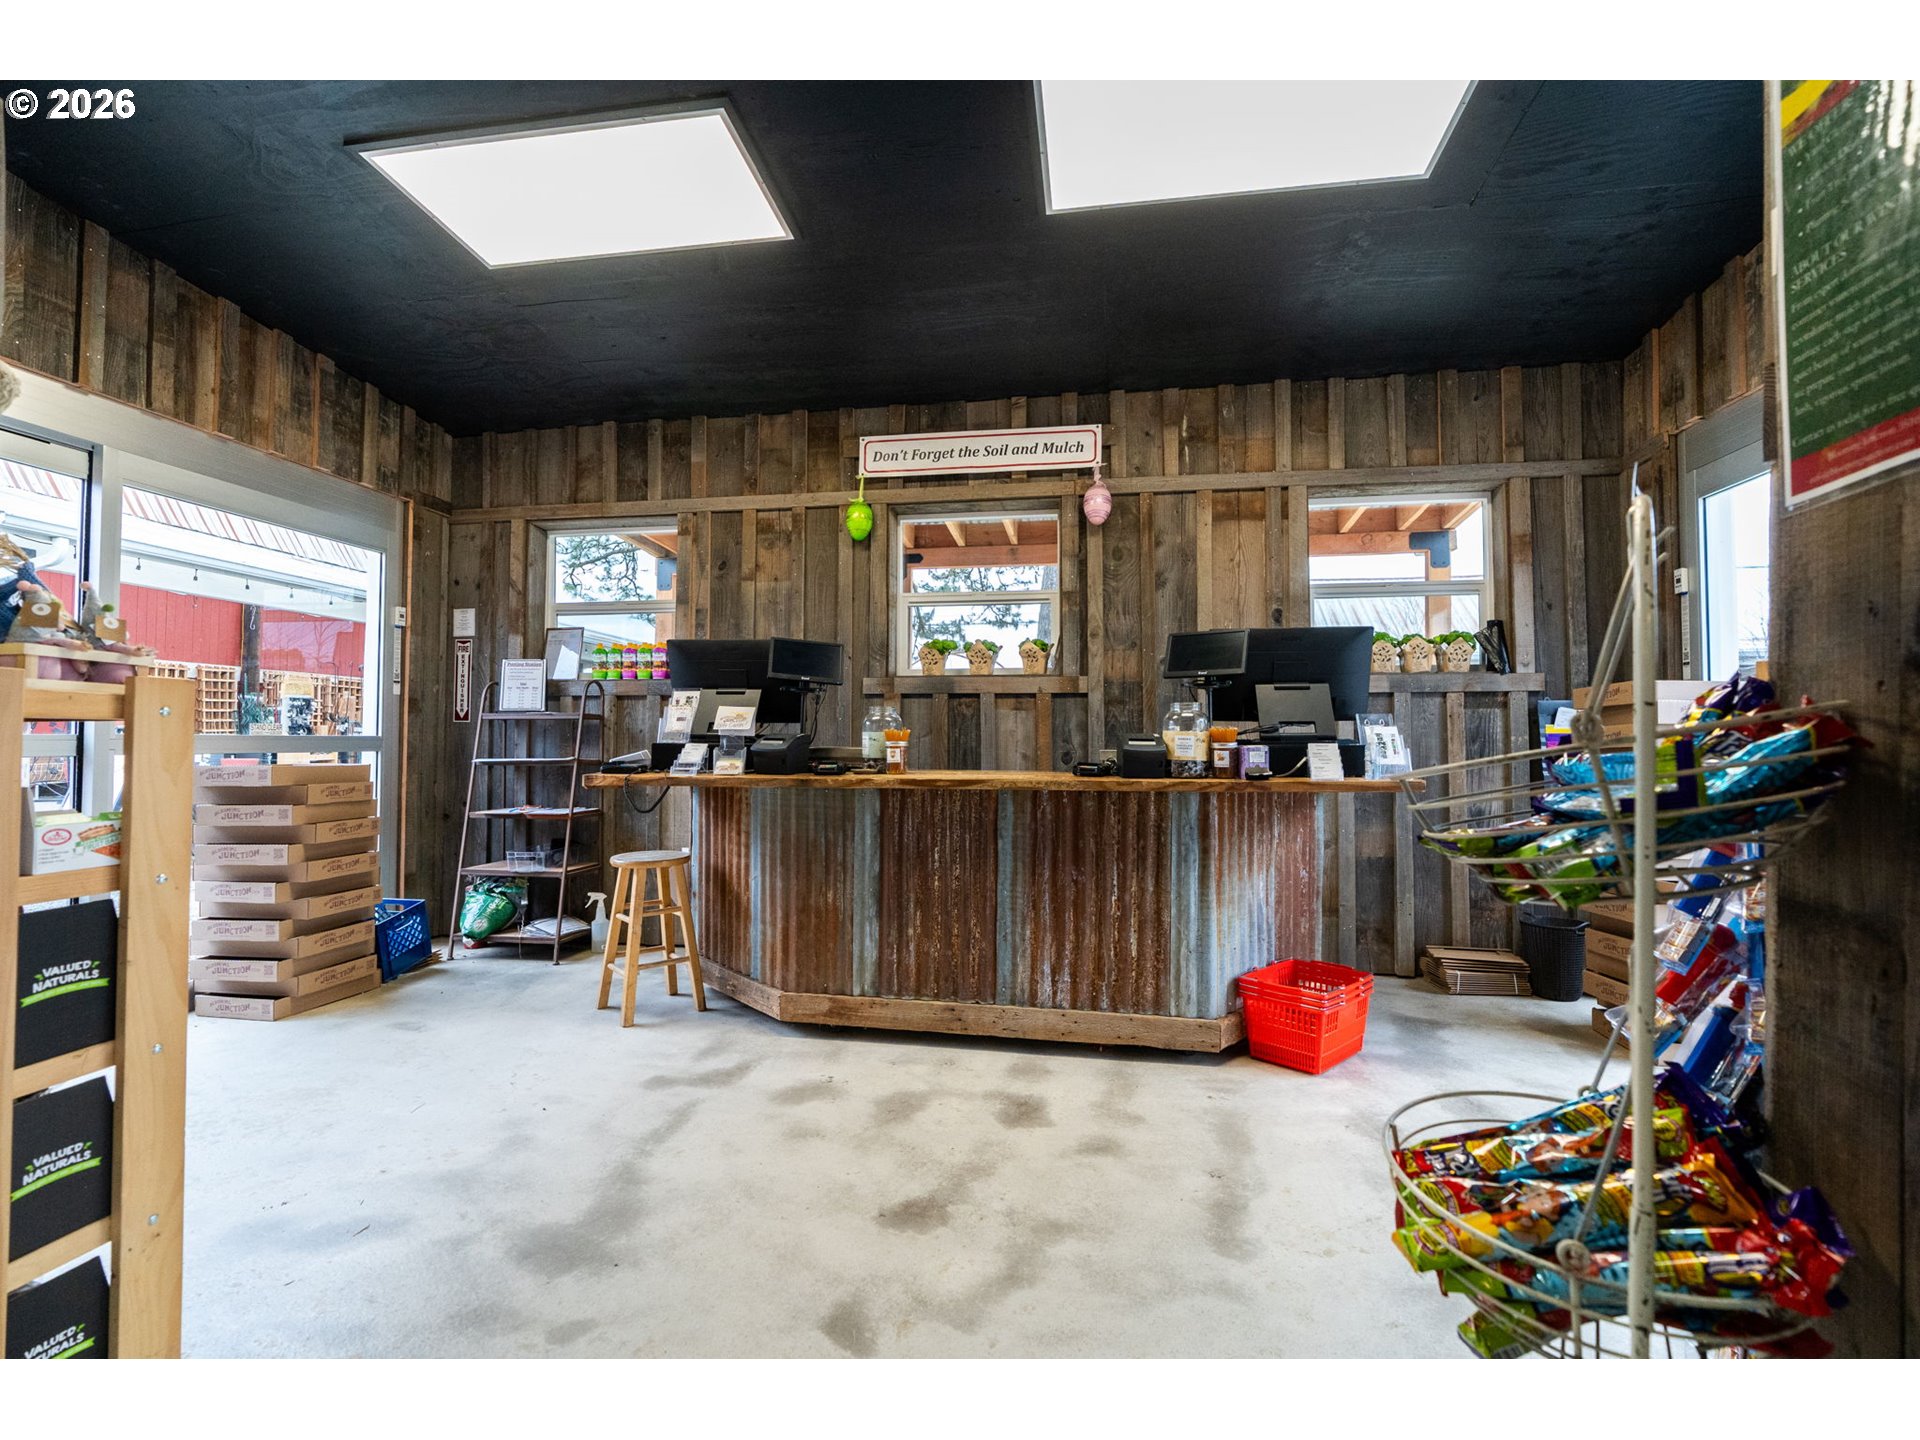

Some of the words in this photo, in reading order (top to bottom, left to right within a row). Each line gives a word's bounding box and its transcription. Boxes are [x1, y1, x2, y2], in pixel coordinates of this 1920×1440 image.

[1791, 251, 1847, 290] SERVICES
[872, 449, 909, 463] Don't
[911, 448, 955, 465] Forget
[958, 446, 980, 459] the
[982, 444, 1008, 457] Soil
[1011, 442, 1038, 456] and
[1042, 441, 1084, 454] Mulch
[458, 645, 469, 653] FIRE
[206, 769, 246, 780] JUNCTION
[221, 809, 265, 821] JUNCTION
[218, 848, 260, 860] JUNCTION
[213, 923, 253, 936] JUNCTION
[42, 960, 92, 978] VALUED
[212, 964, 251, 975] JUNCTION
[32, 969, 100, 993] NATURALS
[215, 1001, 251, 1012] JUNCTION
[33, 1142, 84, 1168] VALUED
[22, 1150, 92, 1186] NATURALS
[24, 1326, 77, 1359] VALUED
